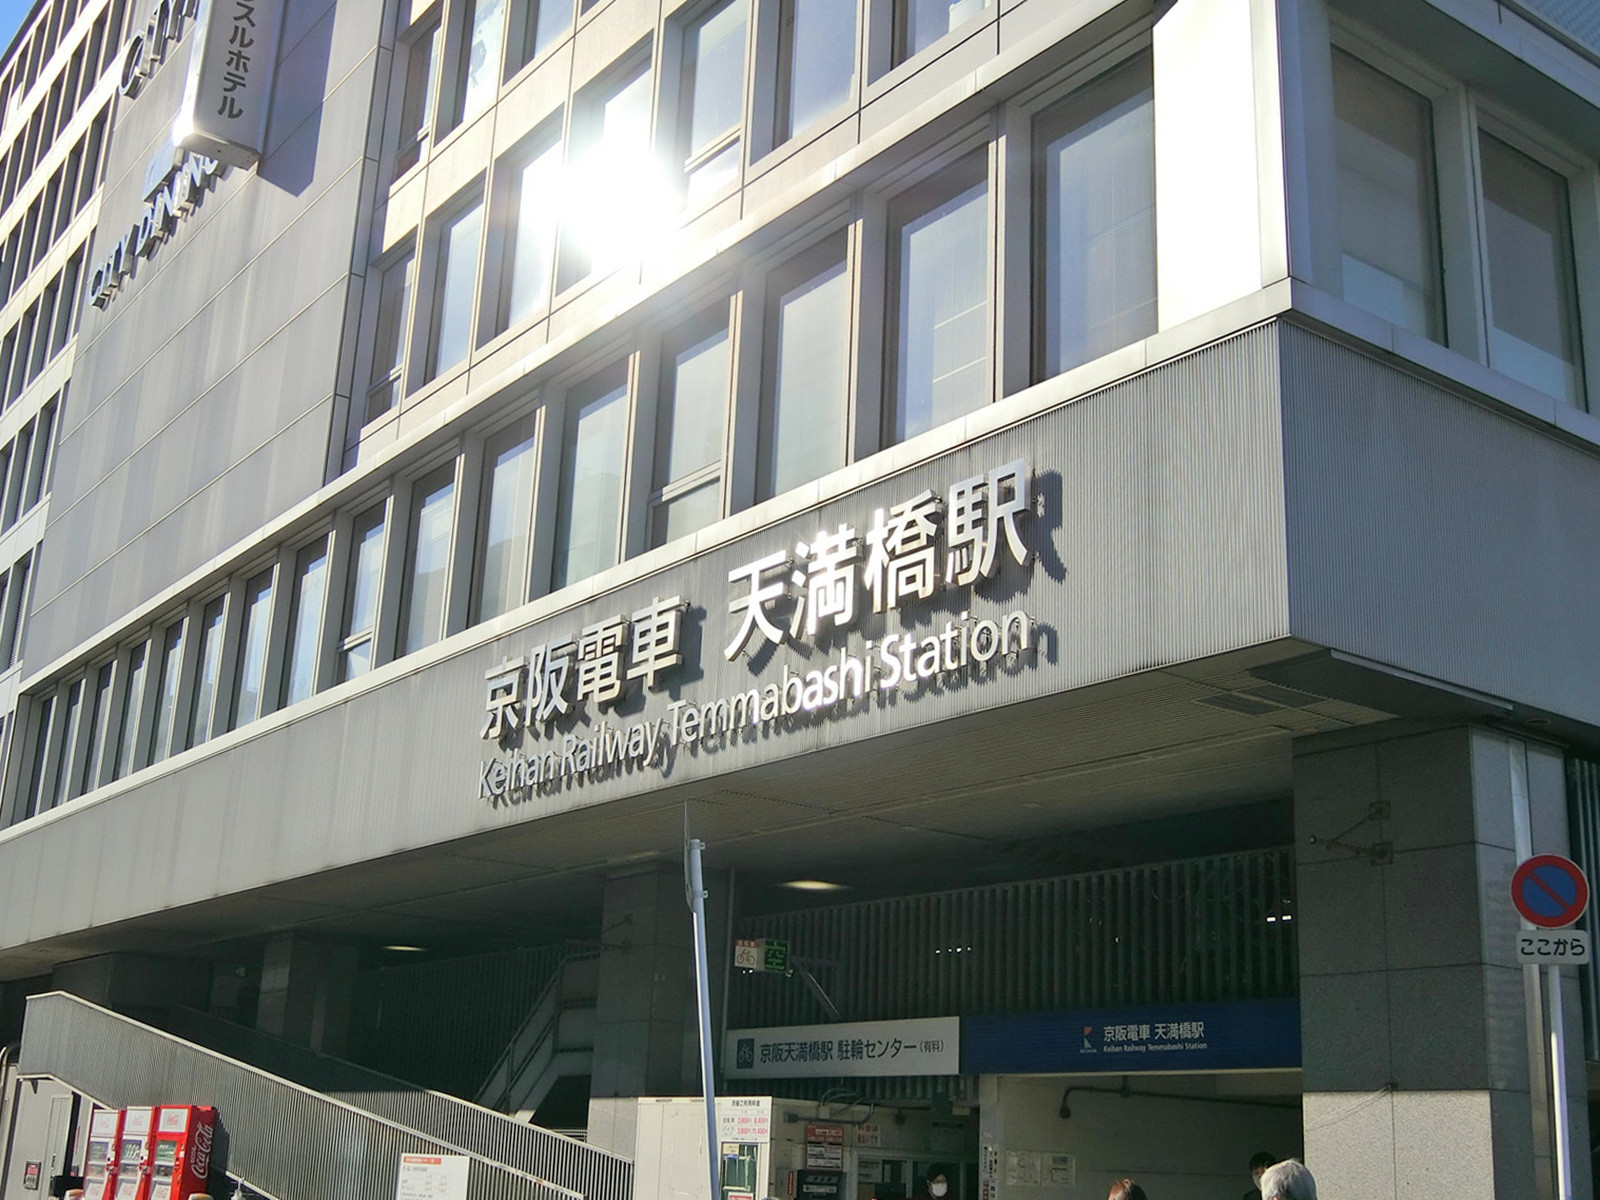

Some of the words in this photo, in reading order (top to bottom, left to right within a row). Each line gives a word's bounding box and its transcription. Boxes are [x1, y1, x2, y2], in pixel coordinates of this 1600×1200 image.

[217, 0, 256, 119] スルホテル
[479, 594, 689, 741] 京阪電車
[724, 459, 1032, 661] 天満橋駅
[477, 748, 554, 799] Keihan
[561, 717, 662, 767] Railway
[667, 640, 872, 746] Temmabashi
[880, 610, 1031, 689] Station
[1520, 938, 1585, 957] ここから
[1103, 1024, 1151, 1042] 京阪電車
[1154, 1021, 1205, 1040] 天満橋駅
[759, 1040, 834, 1064] 京阪天満橋駅
[837, 1037, 917, 1060] 駐輪センター
[1185, 1041, 1208, 1050] Station
